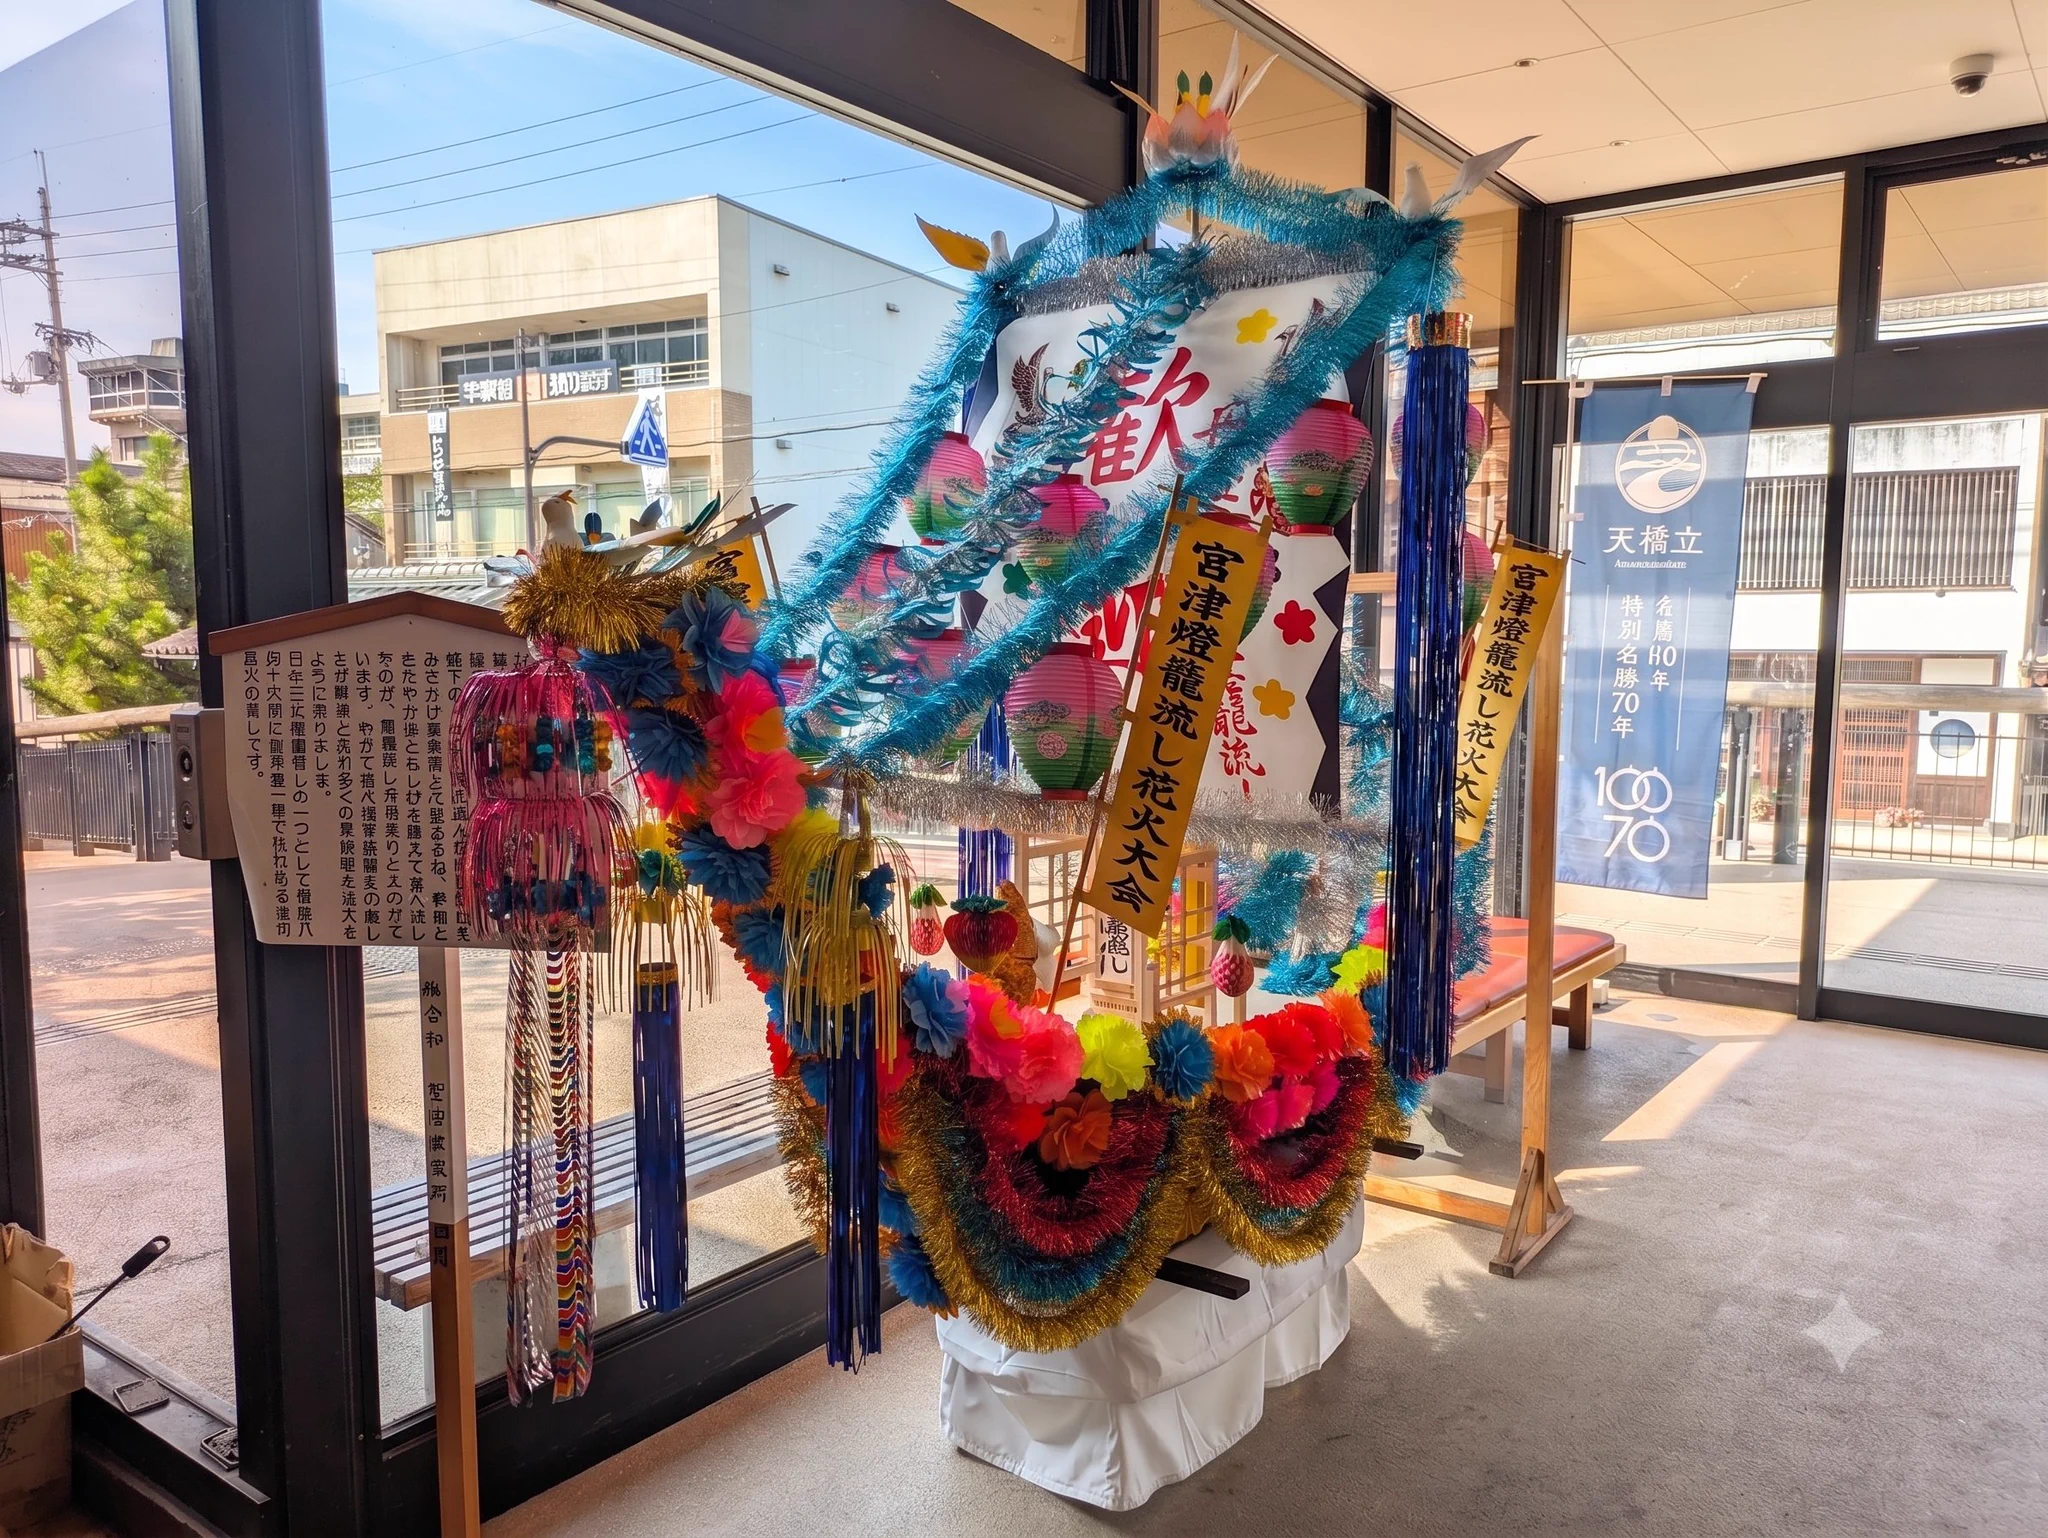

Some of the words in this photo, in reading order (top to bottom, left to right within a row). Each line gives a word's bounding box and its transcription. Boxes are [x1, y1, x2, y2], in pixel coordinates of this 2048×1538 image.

[1602, 524, 1704, 555] 天橋立
[1455, 563, 1549, 824] 宮津燈籠流し花火大会
[1611, 595, 1644, 739] 特別名勝70年
[1105, 540, 1245, 914] 宮津燈籠流し花火大会
[1594, 764, 1673, 814] 100
[1603, 814, 1670, 863] 70
